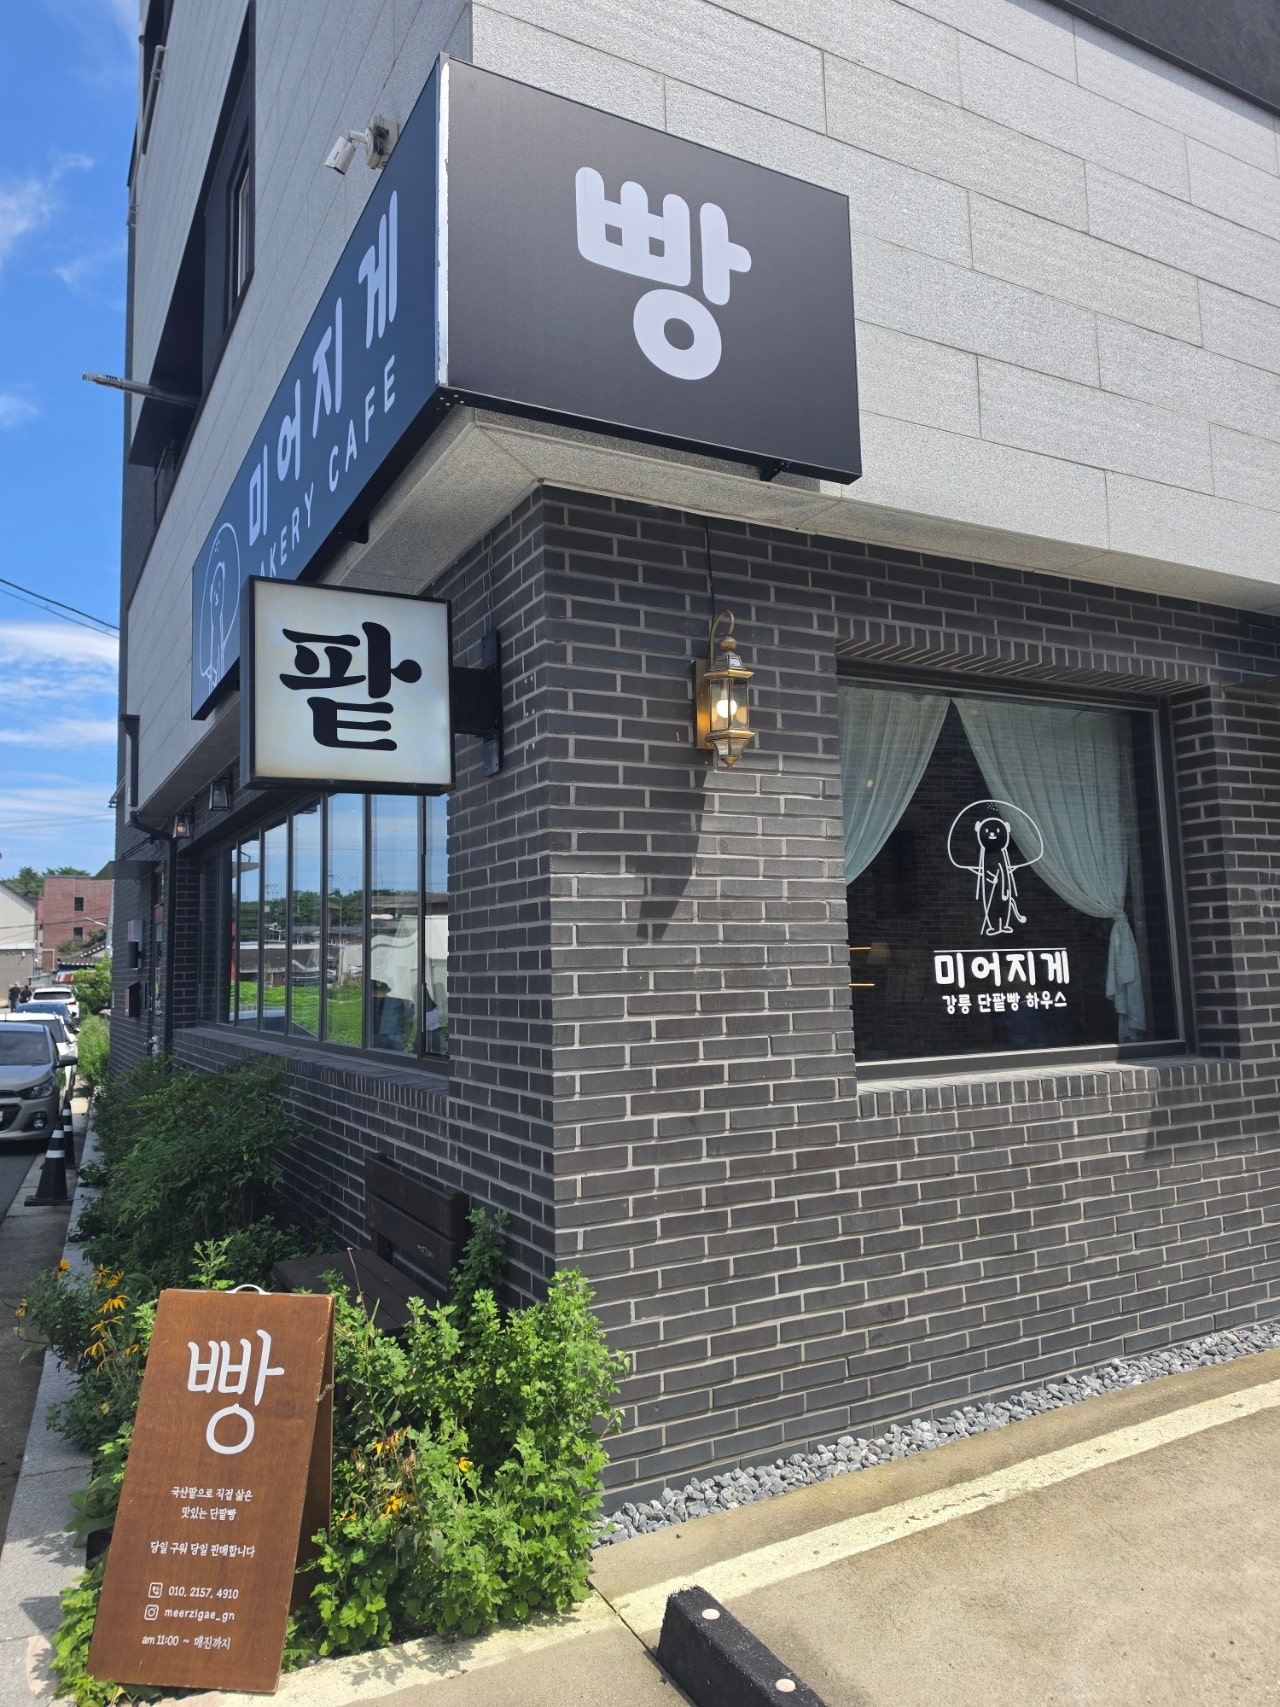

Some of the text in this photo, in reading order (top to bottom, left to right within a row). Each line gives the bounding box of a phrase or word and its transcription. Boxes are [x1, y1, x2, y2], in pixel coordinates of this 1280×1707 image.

[574, 166, 752, 381] 빵
[249, 190, 398, 547] 미어지게
[328, 354, 396, 493] CAFE
[280, 621, 421, 750] 팥
[934, 951, 1070, 989] 미어지게
[942, 990, 1068, 1015] 강릉 단팥빵 하우스
[187, 1329, 285, 1455] 빵
[171, 1486, 253, 1502] 국산팥으로 직접 삶은
[181, 1506, 237, 1521] 맛있는 단팥빵
[150, 1541, 256, 1558] 당일 구워 당일 판매합니다
[216, 1588, 239, 1599] 4910
[141, 1635, 155, 1645] am
[156, 1635, 179, 1646] 11:00
[194, 1635, 231, 1650] 매진까지
